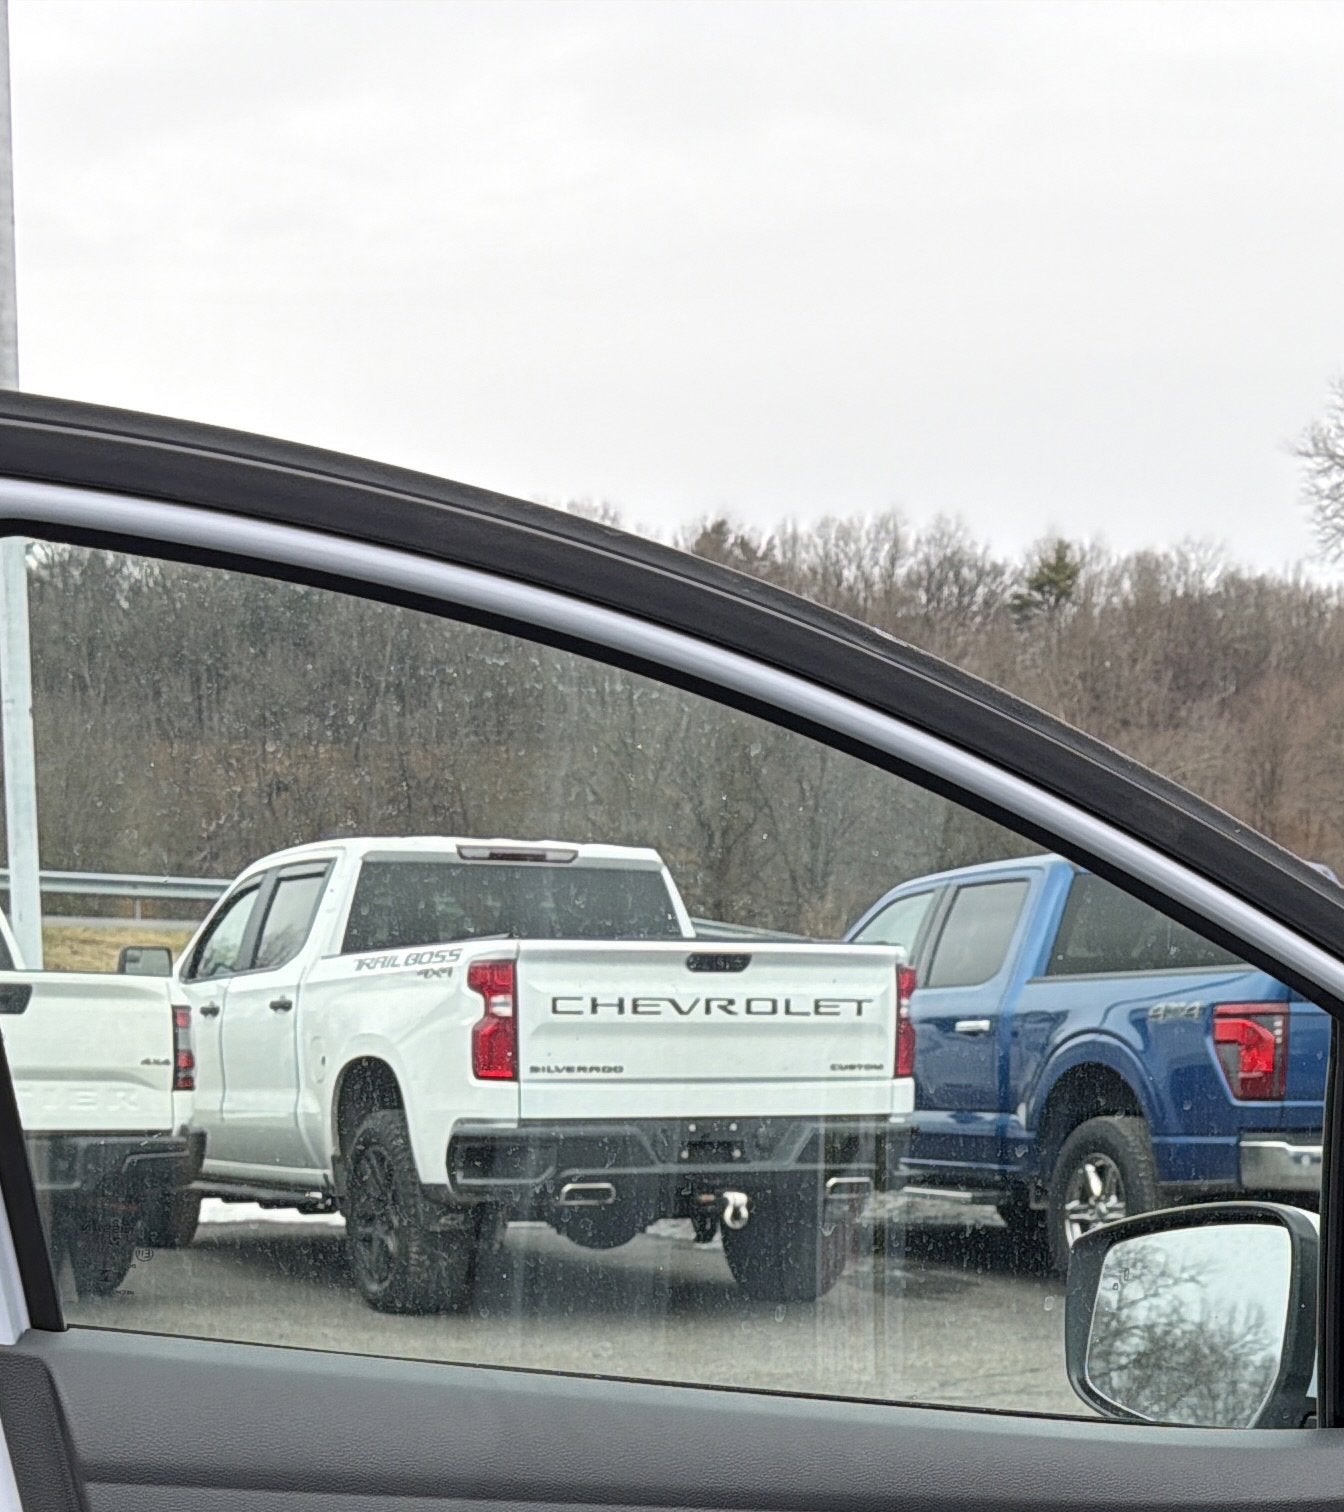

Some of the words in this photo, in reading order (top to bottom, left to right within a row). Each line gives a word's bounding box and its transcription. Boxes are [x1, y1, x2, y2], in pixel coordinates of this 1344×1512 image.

[355, 956, 401, 971] TRAIL
[403, 948, 464, 967] BOSS
[551, 997, 874, 1017] CHEVROLET
[529, 1064, 625, 1075] SILVERADO
[829, 1062, 885, 1072] CUSTOM
